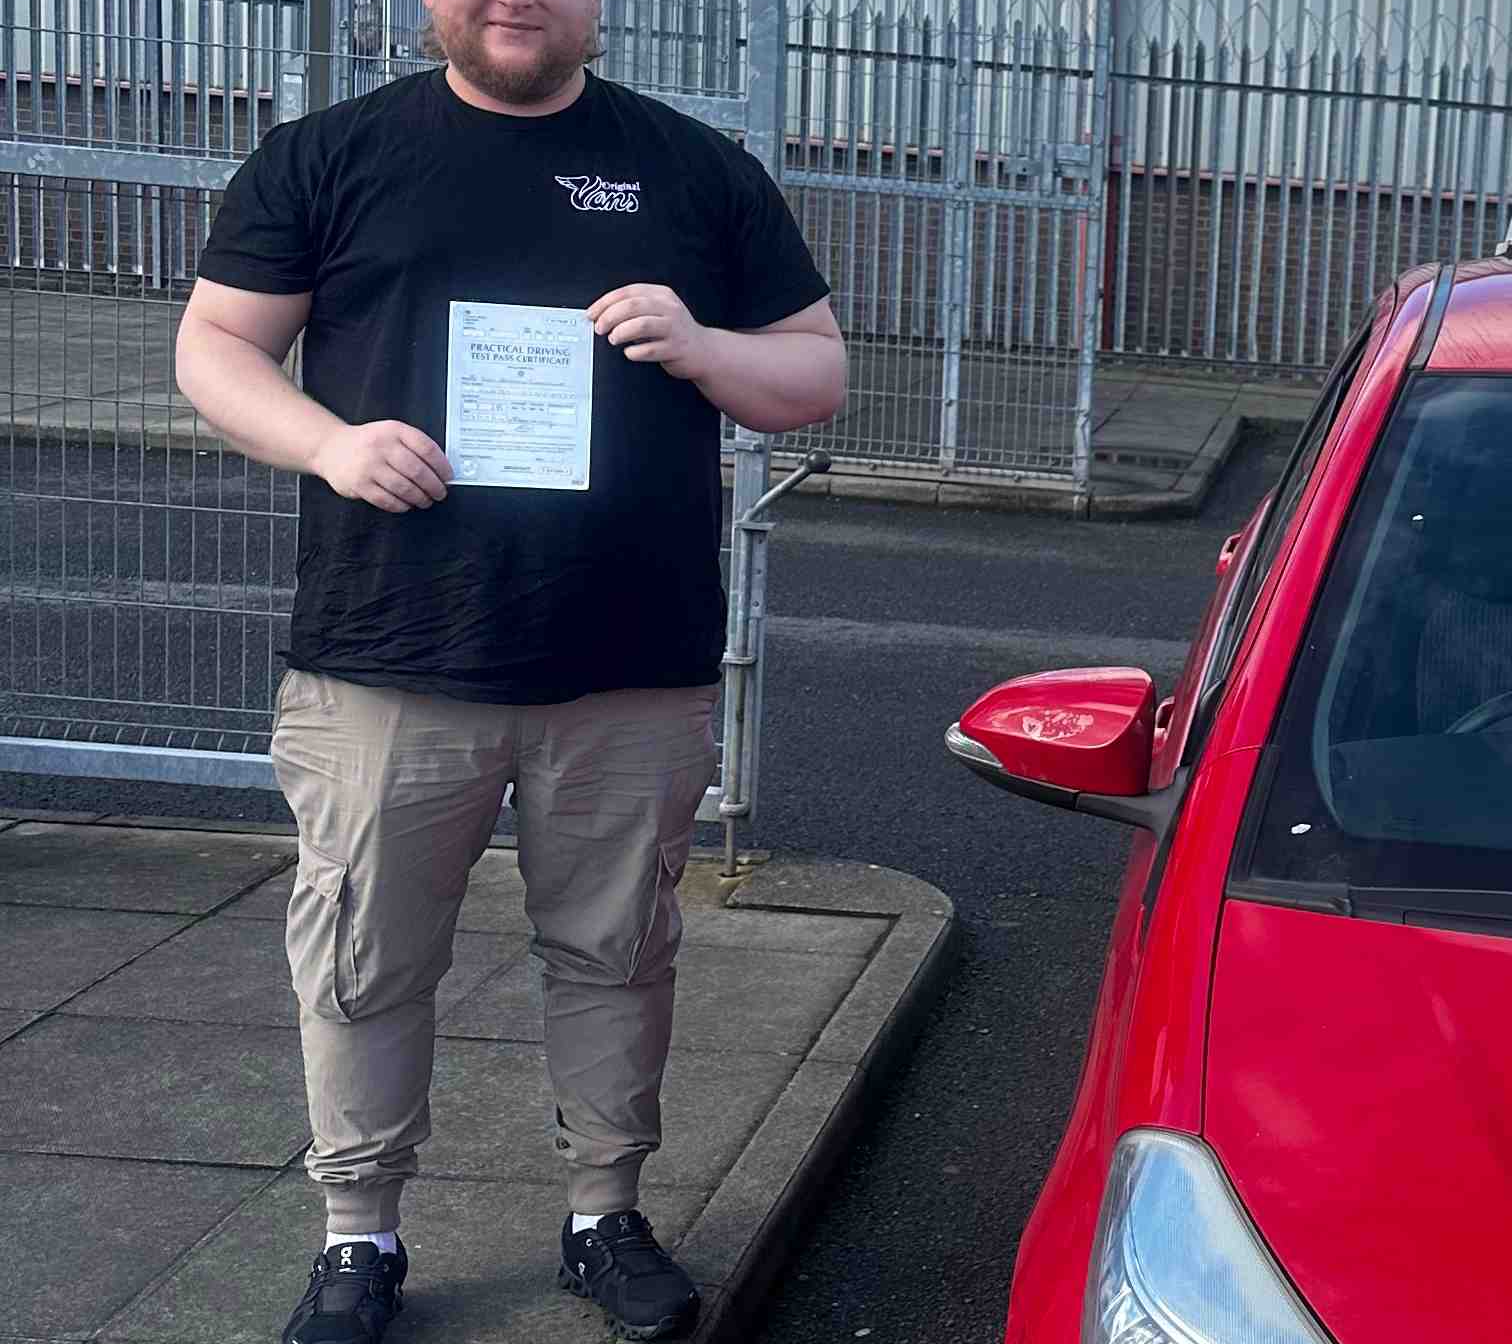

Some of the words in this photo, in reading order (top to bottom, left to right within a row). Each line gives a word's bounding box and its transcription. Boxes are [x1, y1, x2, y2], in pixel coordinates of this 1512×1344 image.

[601, 181, 641, 192] Original
[555, 175, 640, 213] Vans
[470, 343, 524, 354] PRACTICAL
[527, 346, 570, 357] DRIVING
[471, 352, 490, 361] TEST
[493, 353, 514, 362] PASS
[516, 355, 569, 366] CERTIFICATE
